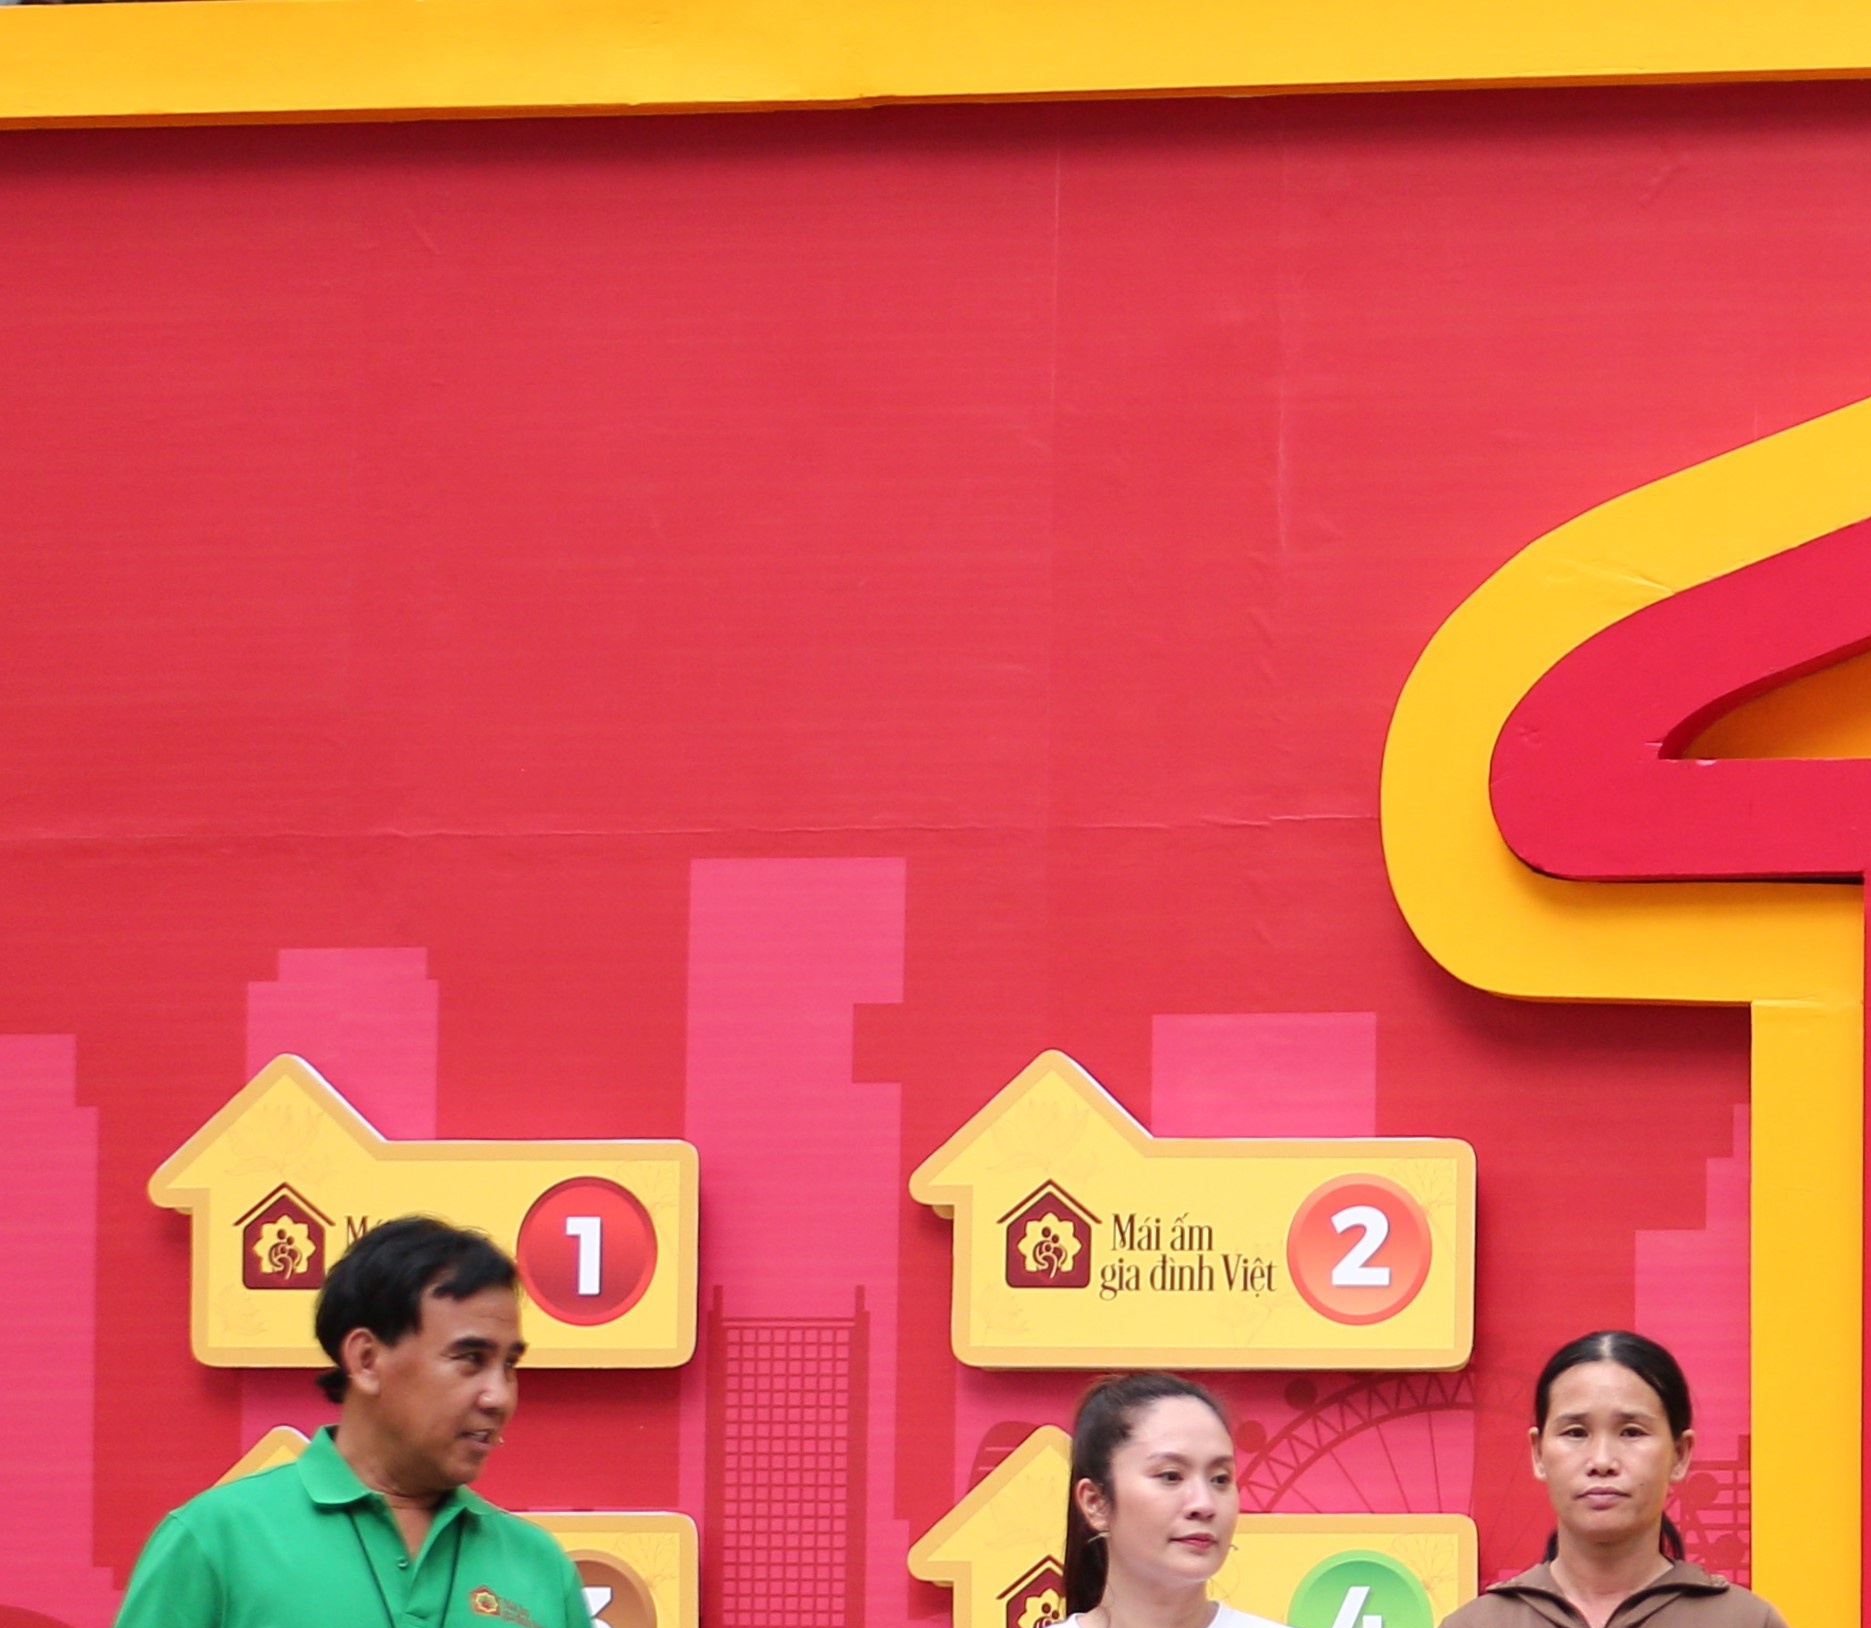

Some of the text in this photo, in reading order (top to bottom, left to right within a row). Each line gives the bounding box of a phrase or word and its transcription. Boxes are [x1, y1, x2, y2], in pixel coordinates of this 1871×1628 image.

[565, 1216, 602, 1295] 1
[1111, 1211, 1214, 1251] Mái ấm
[1329, 1205, 1392, 1287] 2
[1098, 1253, 1278, 1301] gia đình Việt
